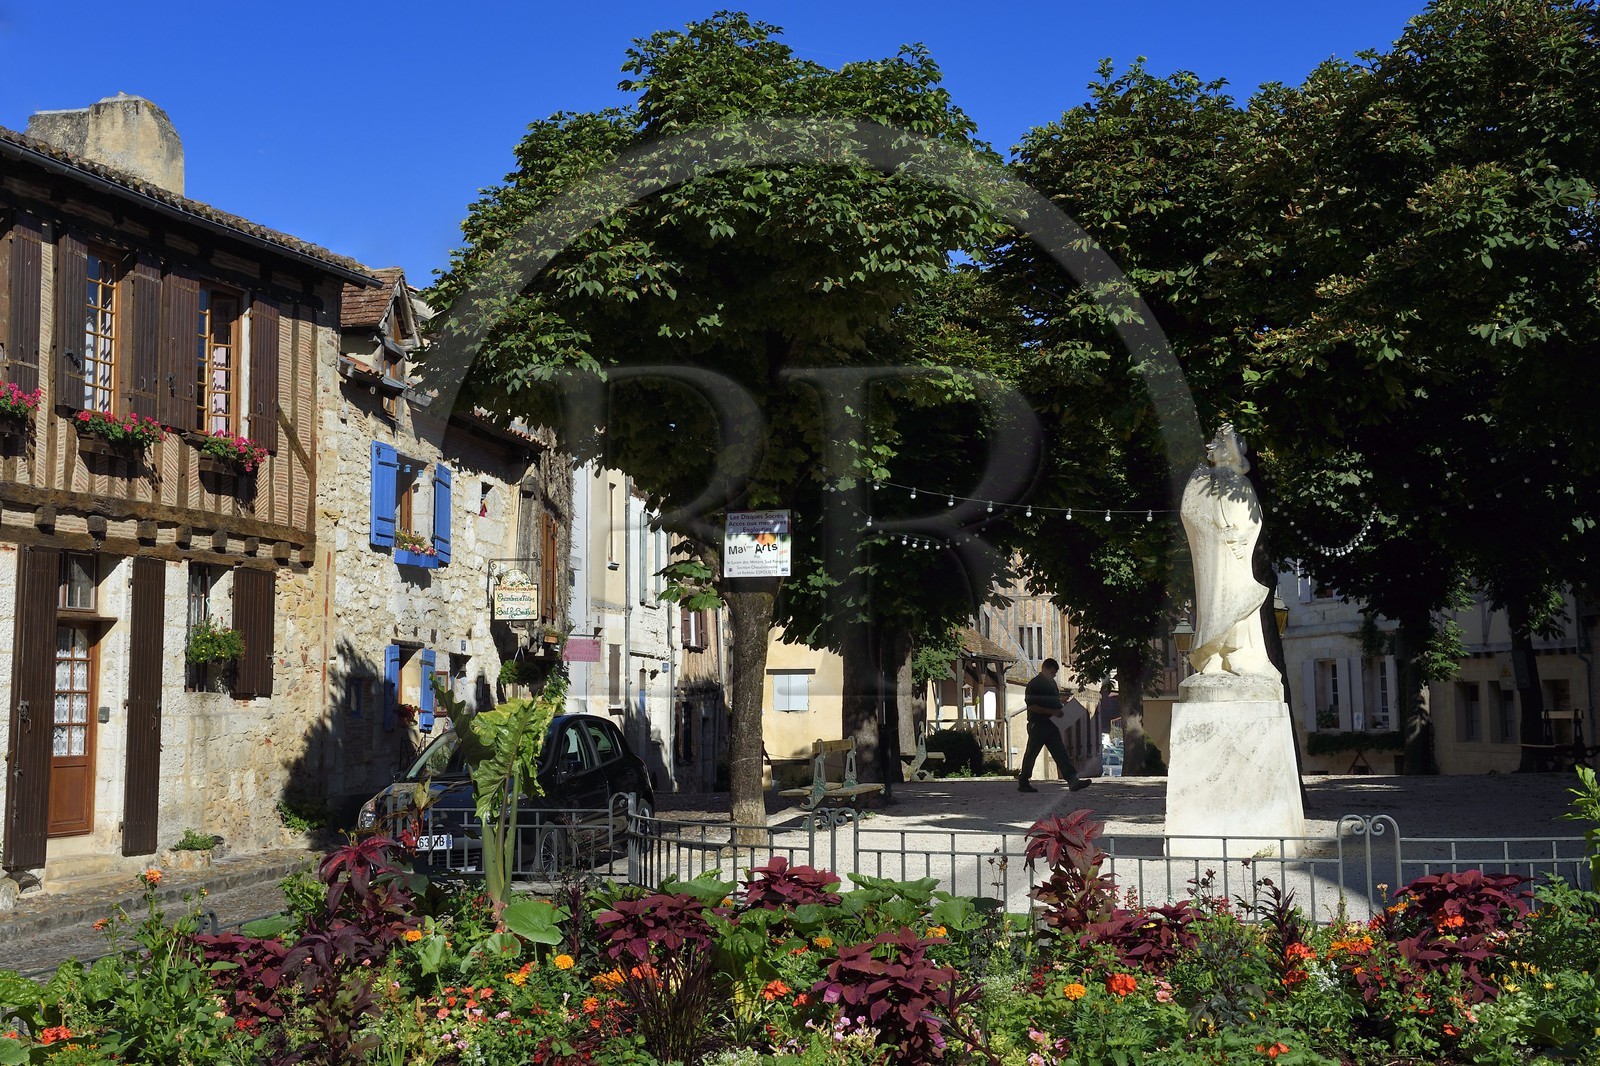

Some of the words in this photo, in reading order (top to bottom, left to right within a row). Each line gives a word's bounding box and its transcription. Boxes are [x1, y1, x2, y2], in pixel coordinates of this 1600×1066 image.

[740, 513, 763, 521] Disques
[728, 543, 747, 555] Mai
[754, 542, 778, 555] Arts
